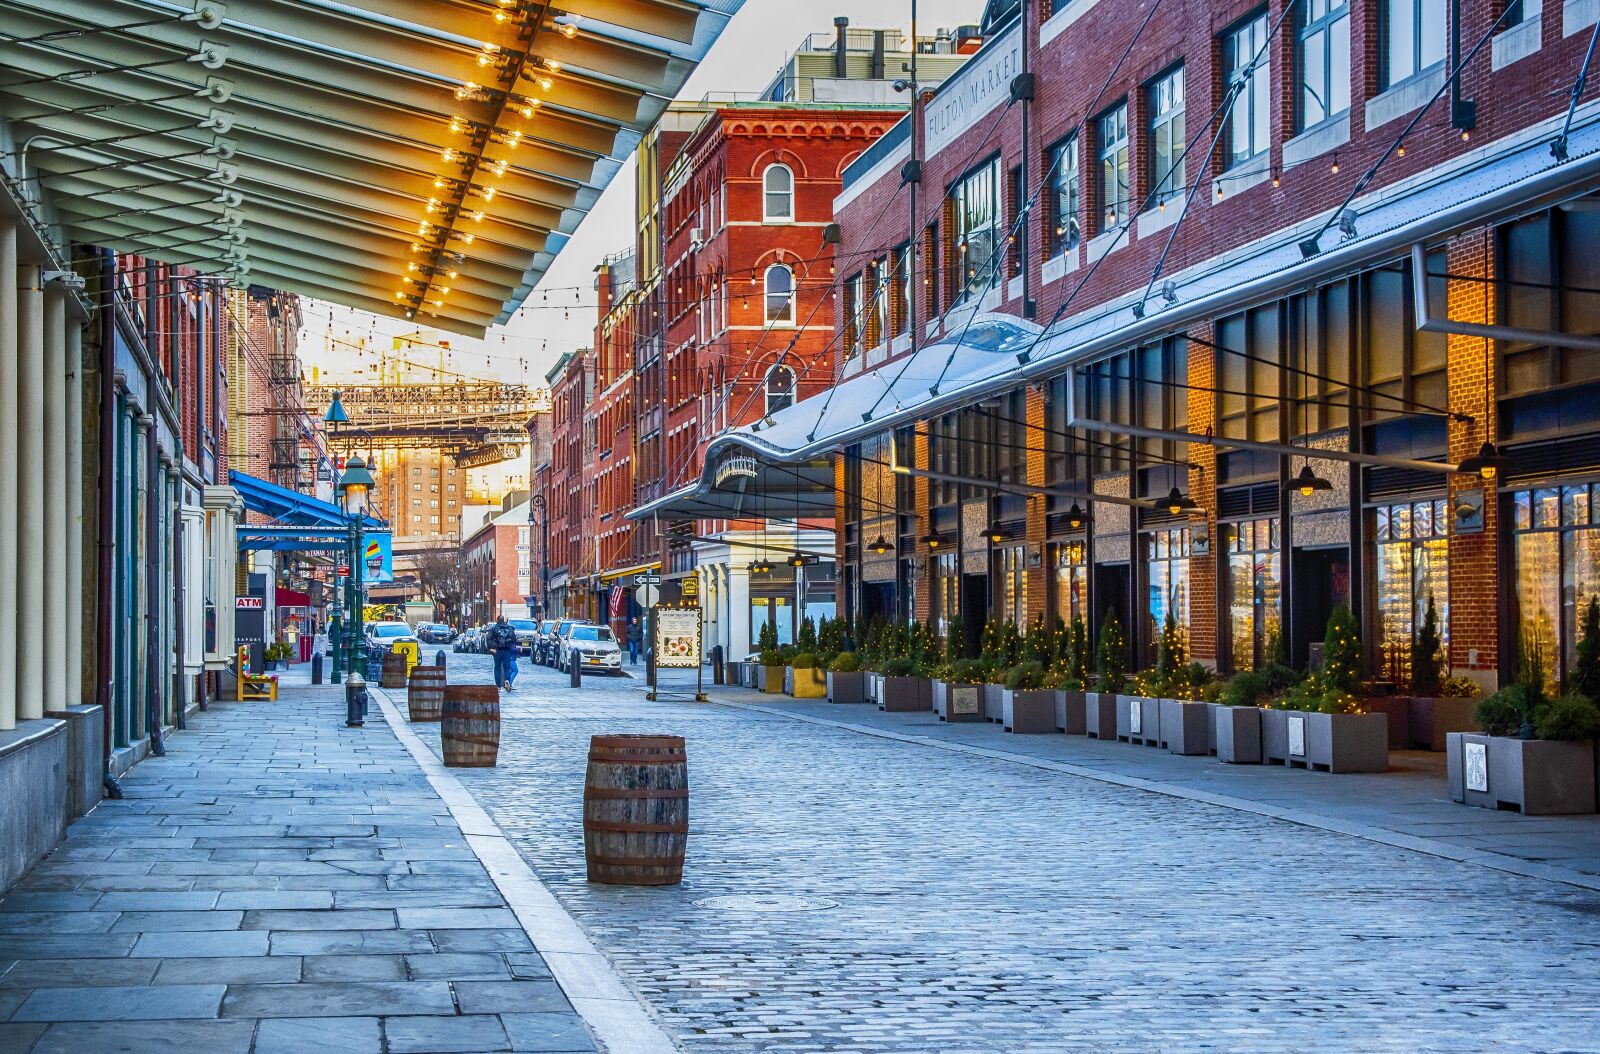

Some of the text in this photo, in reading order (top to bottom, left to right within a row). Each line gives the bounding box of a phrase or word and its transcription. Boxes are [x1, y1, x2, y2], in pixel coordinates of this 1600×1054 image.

[929, 47, 1018, 141] FULTON MARKET
[237, 598, 262, 607] ATM
